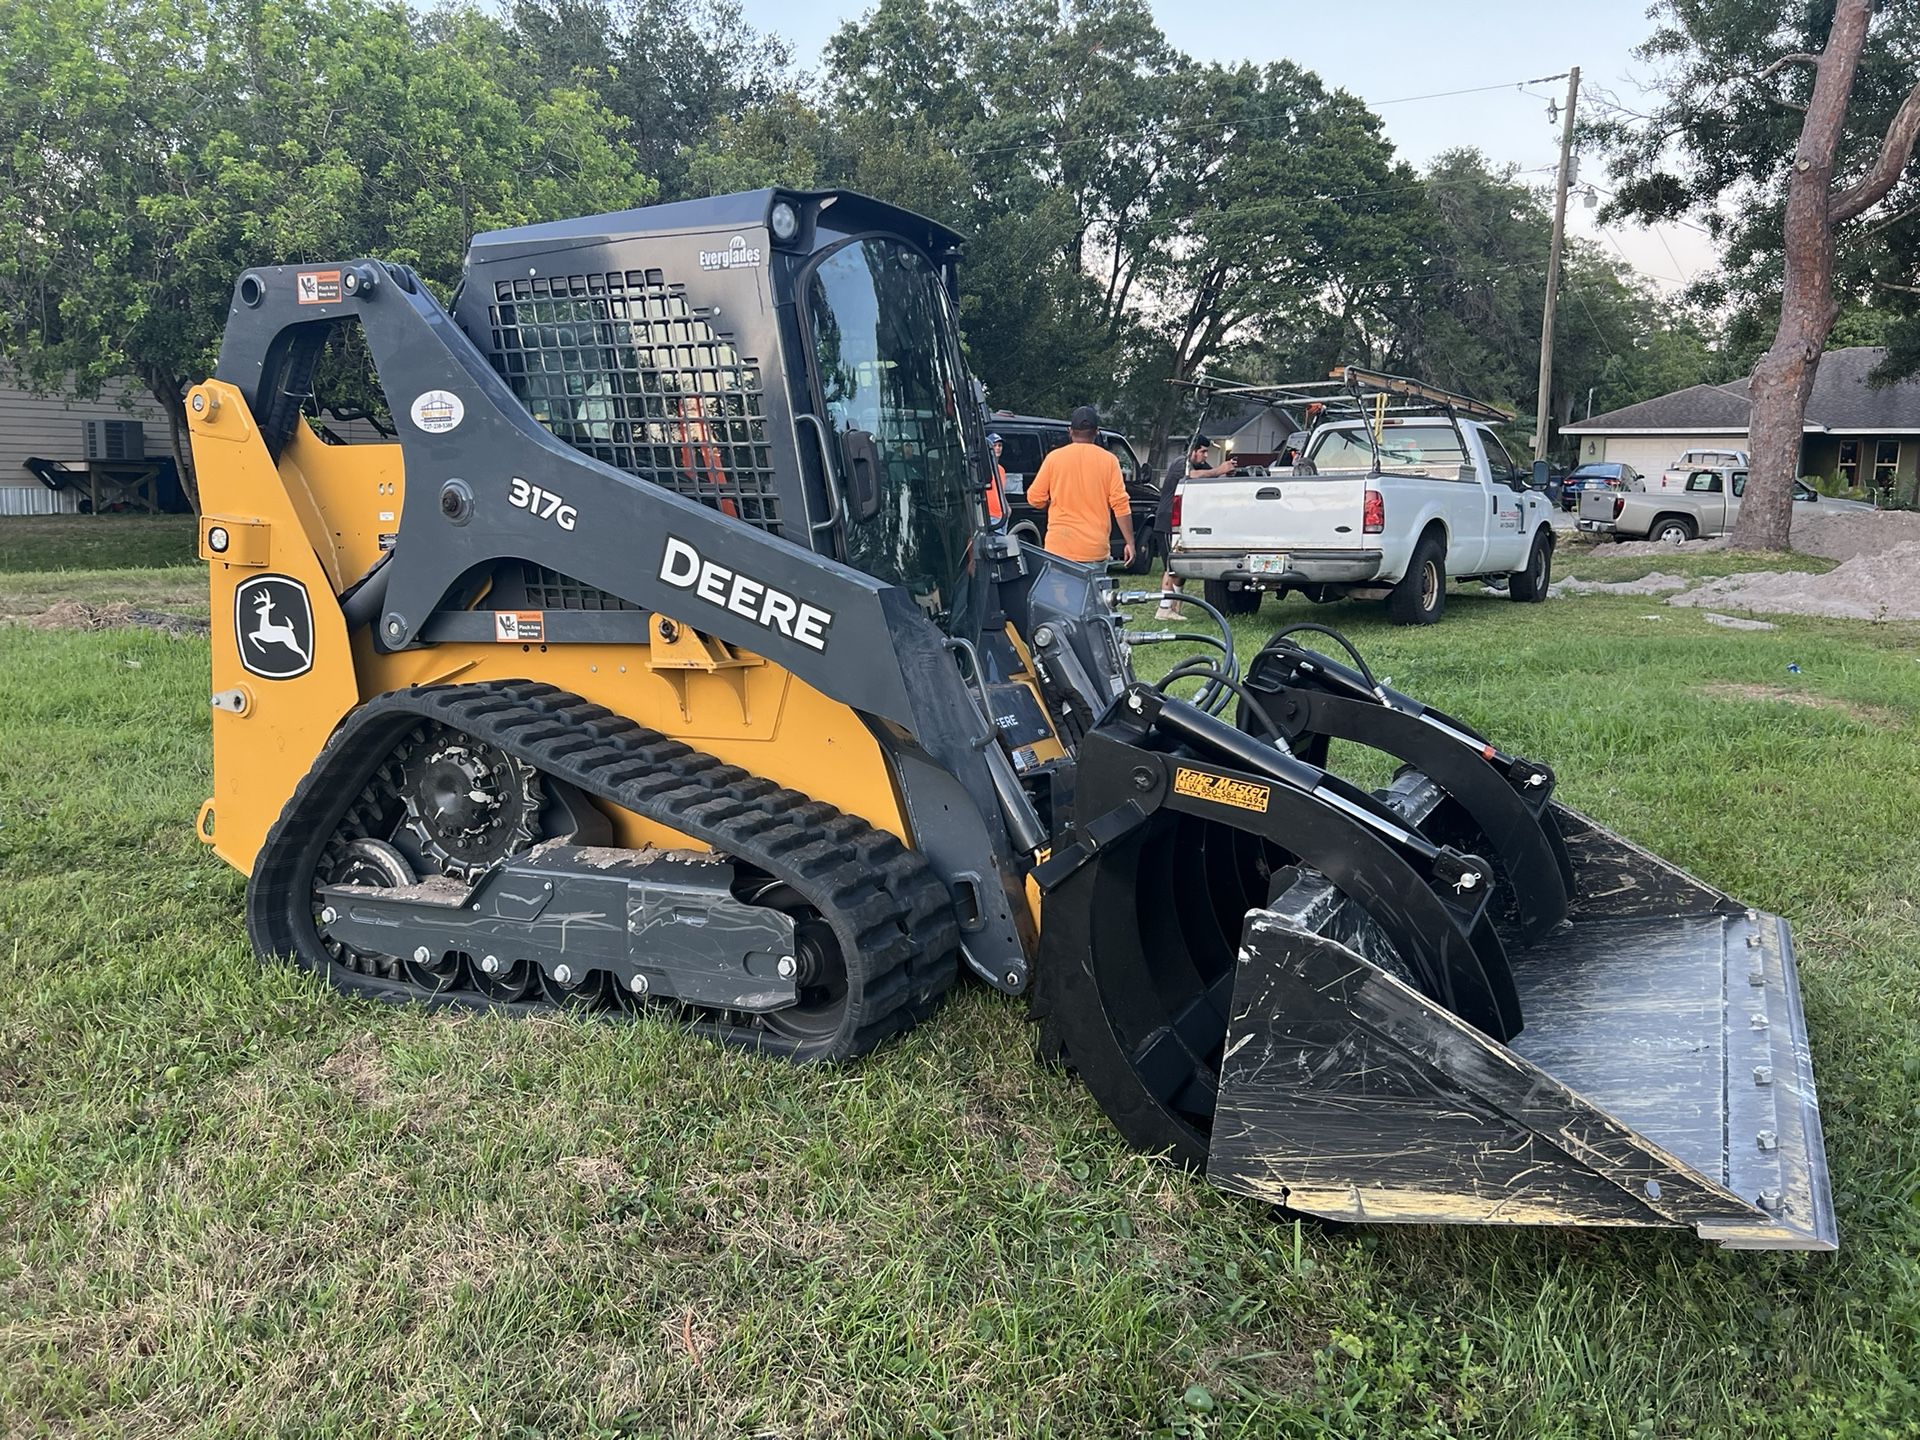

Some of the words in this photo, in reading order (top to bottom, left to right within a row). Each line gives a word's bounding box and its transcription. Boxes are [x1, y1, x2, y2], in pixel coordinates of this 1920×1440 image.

[699, 247, 760, 268] Everglades
[508, 477, 578, 531] 317G
[659, 537, 831, 651] DEERE
[1177, 769, 1213, 787] Rake
[1213, 778, 1268, 798] Master
[1201, 787, 1264, 806] 850-584-4494
